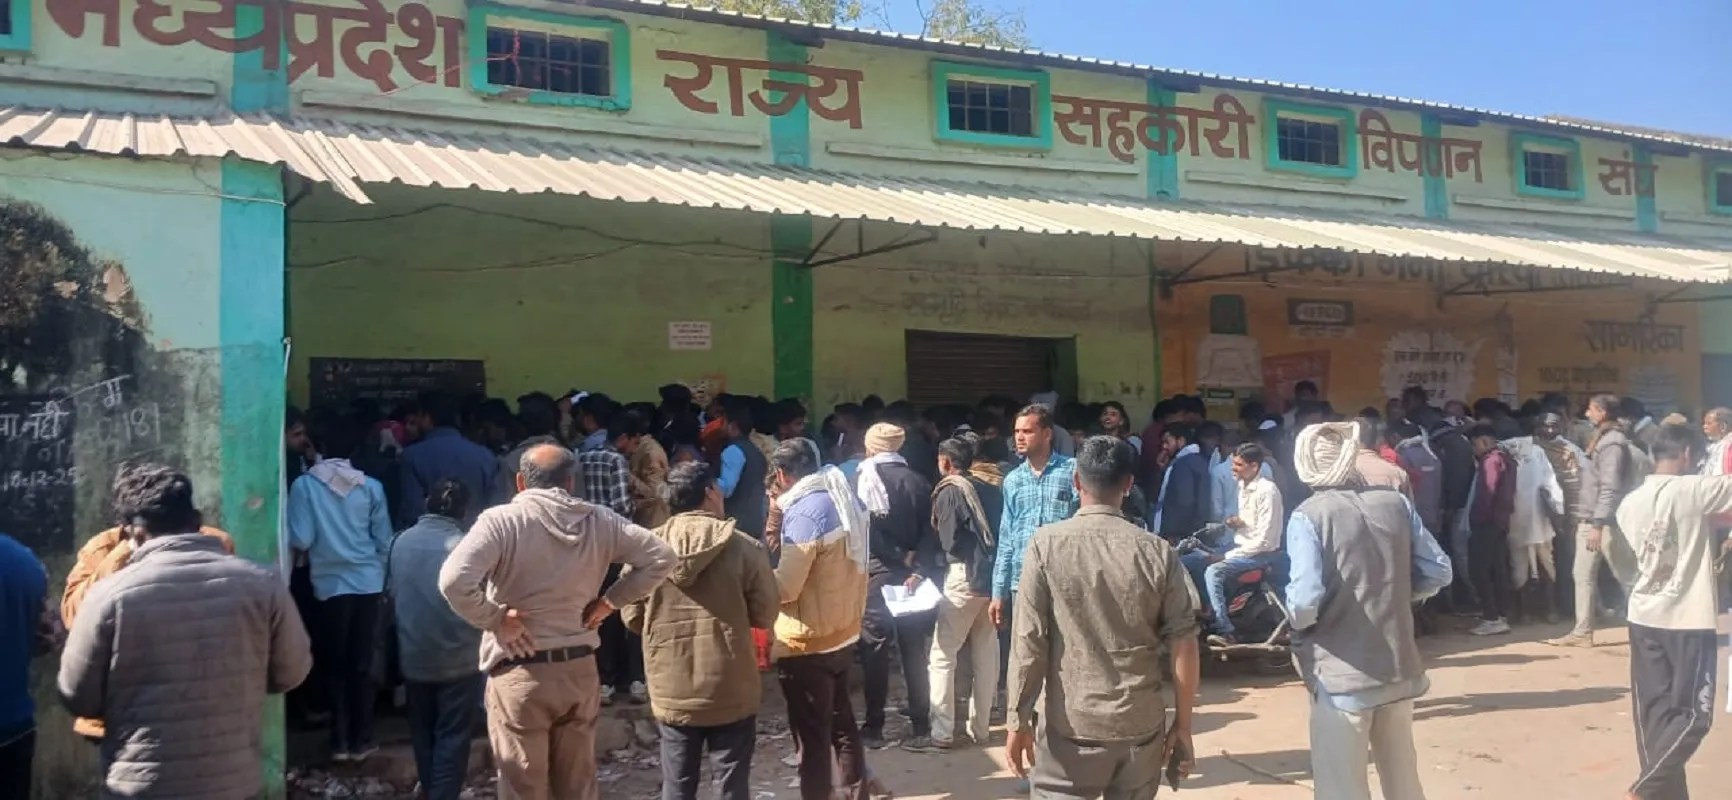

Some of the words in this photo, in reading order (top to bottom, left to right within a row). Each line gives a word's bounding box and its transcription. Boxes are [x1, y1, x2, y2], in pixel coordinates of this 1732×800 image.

[656, 49, 863, 129] राज्य
[1051, 94, 1255, 164] सहकारी
[1356, 108, 1483, 183] विपणन
